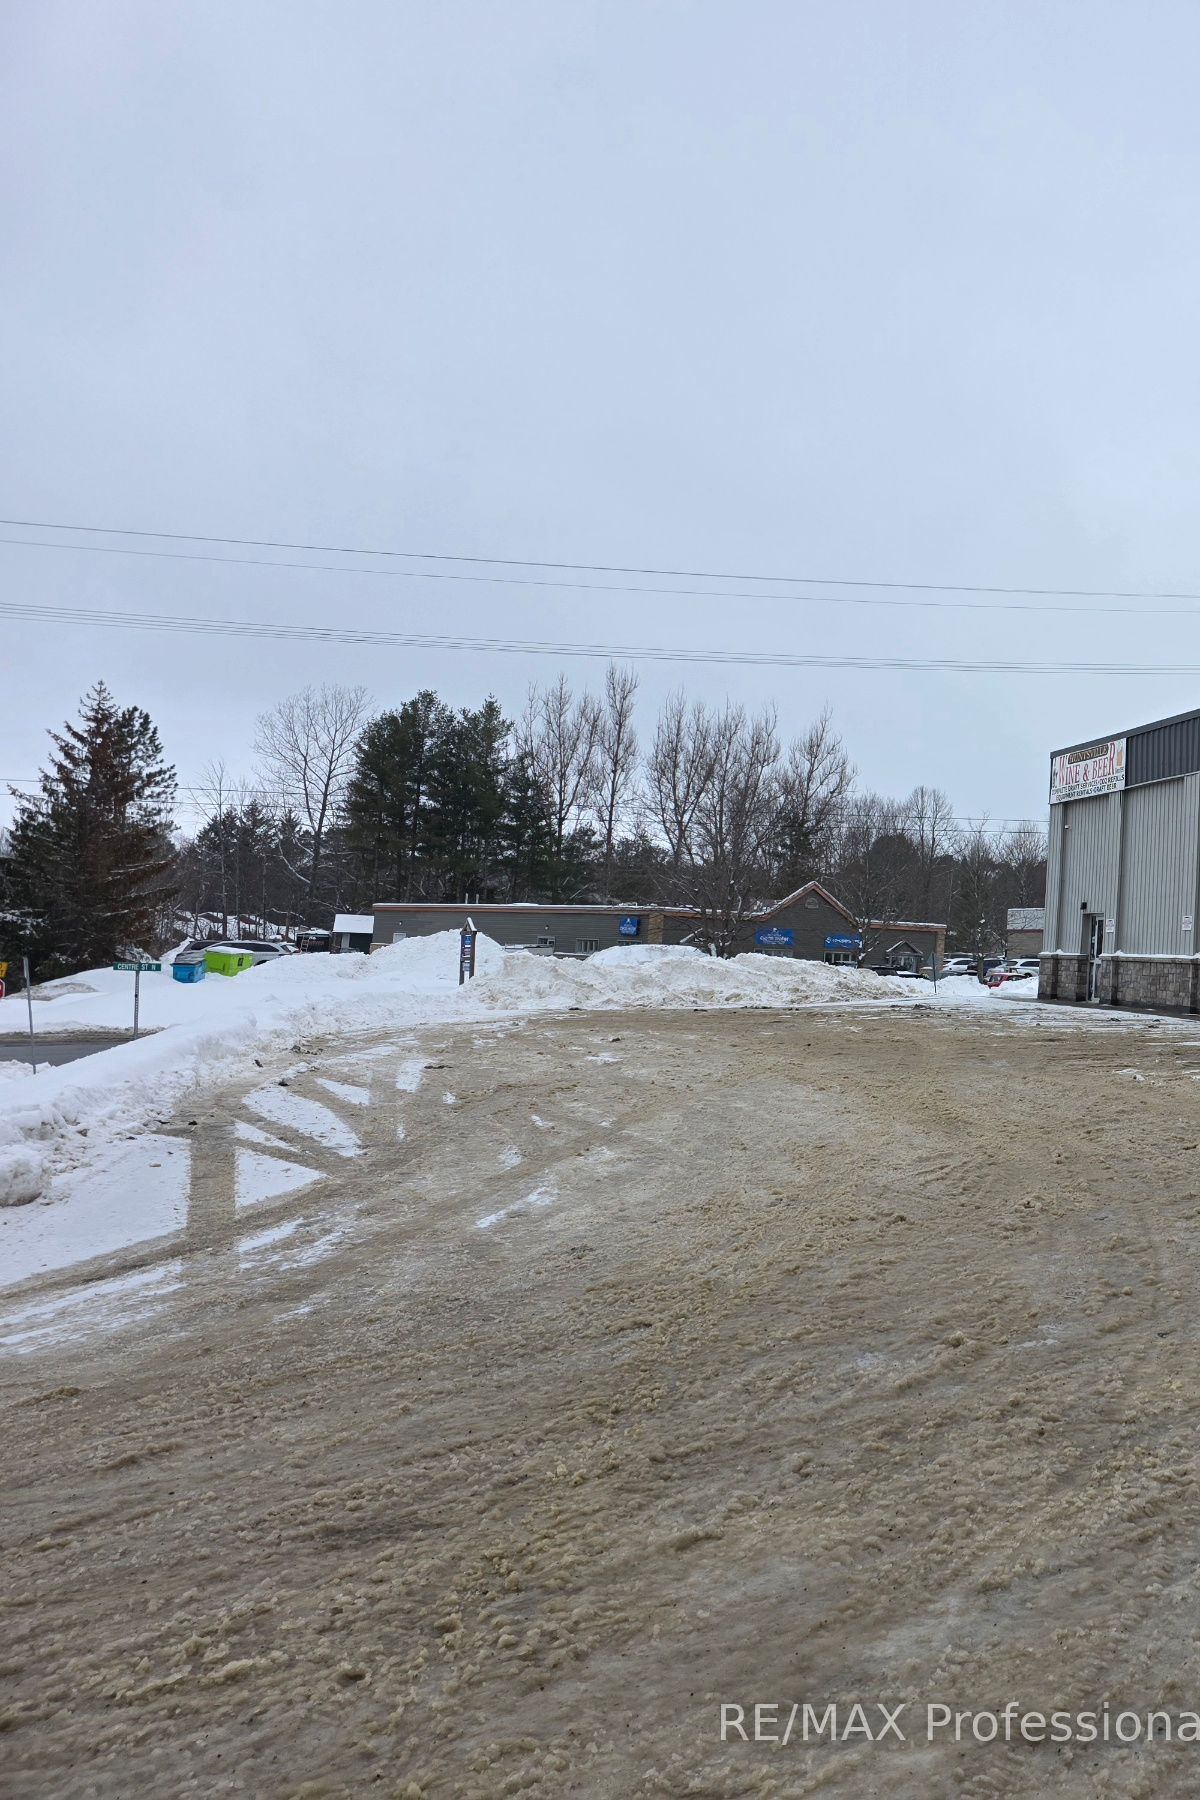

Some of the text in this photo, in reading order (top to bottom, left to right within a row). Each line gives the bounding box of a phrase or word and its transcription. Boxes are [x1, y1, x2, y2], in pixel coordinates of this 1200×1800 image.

[1059, 742, 1116, 785] WINE & BEER
[117, 962, 139, 971] CENTRE
[141, 963, 149, 971] ST
